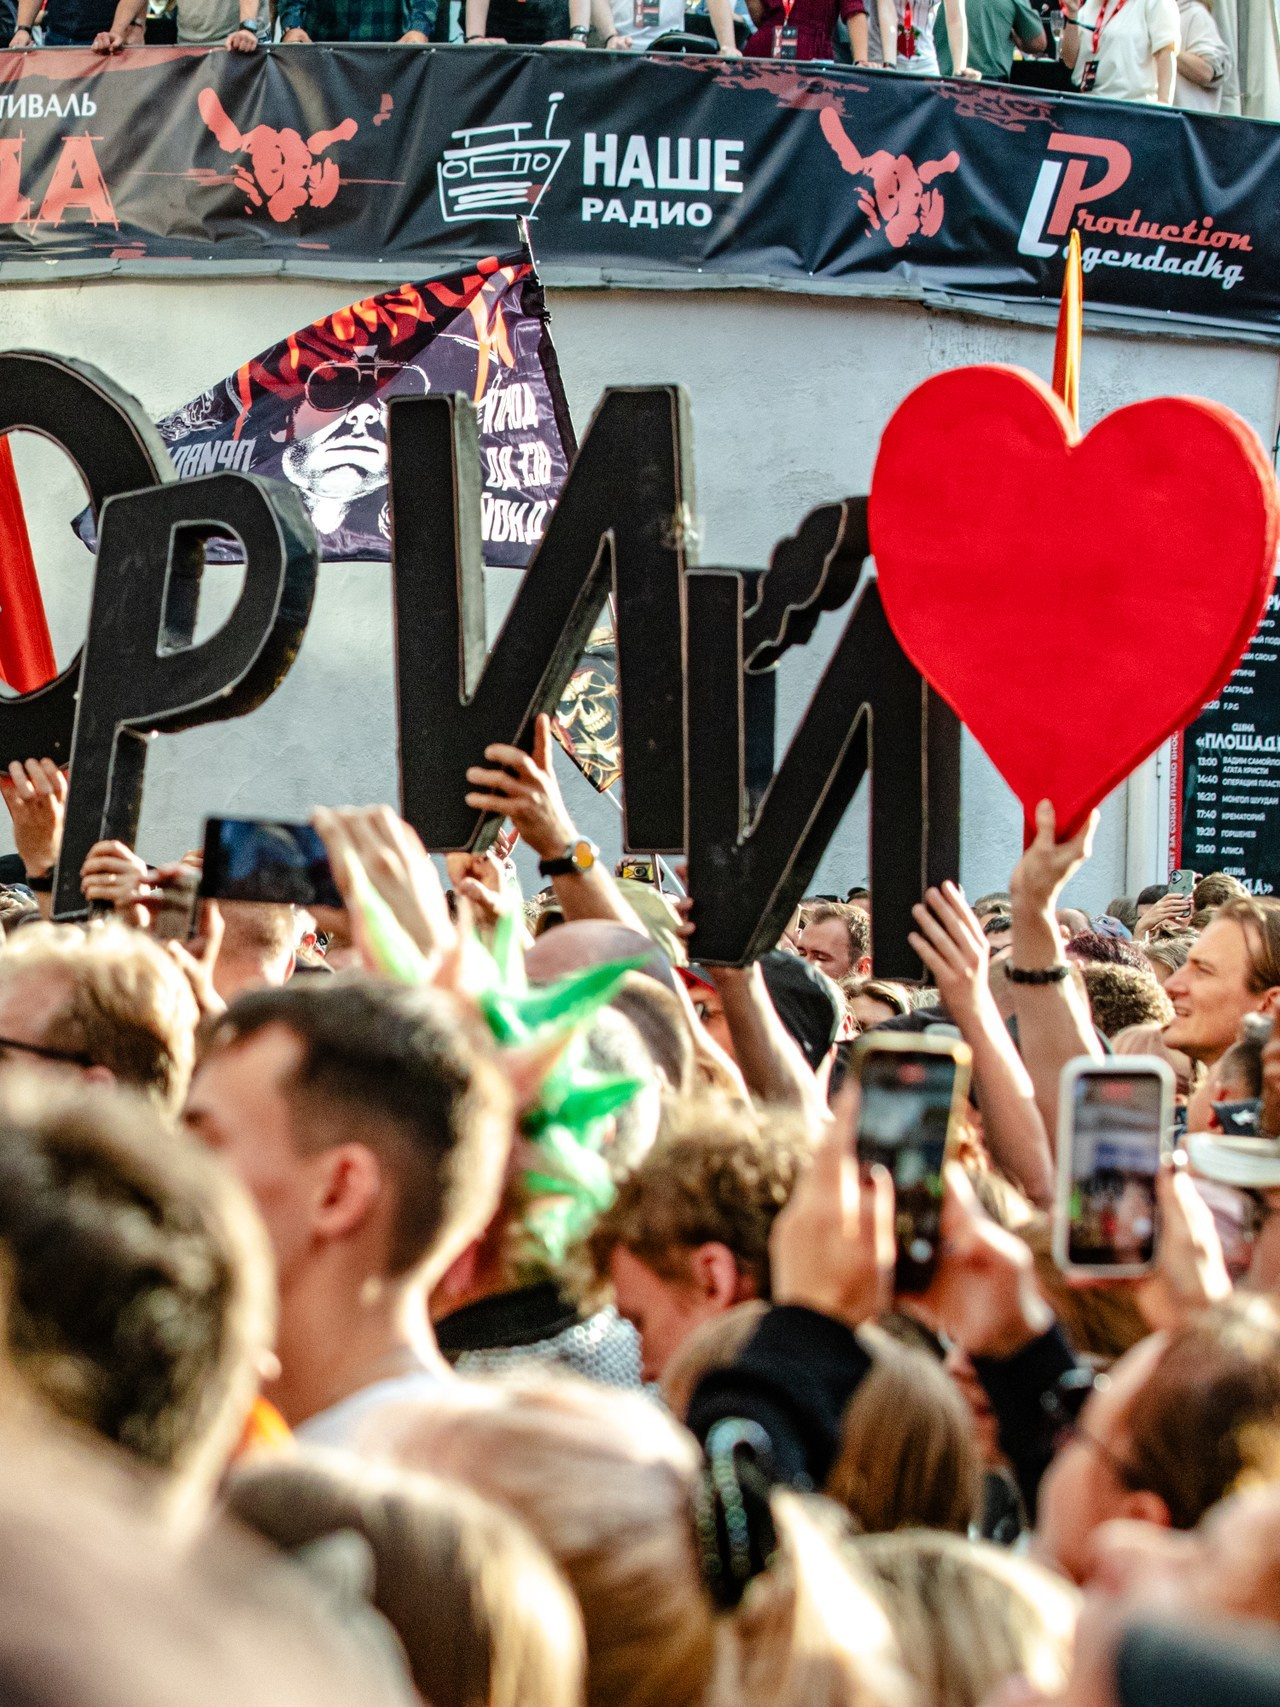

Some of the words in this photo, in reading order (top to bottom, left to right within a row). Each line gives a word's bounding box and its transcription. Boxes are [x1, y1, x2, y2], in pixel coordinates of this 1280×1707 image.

[582, 132, 744, 193] НАШЕ
[581, 197, 713, 229] РАДИО
[1231, 723, 1255, 732] СЦЕНА
[1198, 757, 1218, 766] 13:00
[1222, 756, 1247, 765] ВАДИМ
[1248, 757, 1280, 766] САМОЙЛО
[1197, 775, 1218, 784] 14:40
[1250, 797, 1279, 805] ШУУДАН
[1196, 810, 1217, 819] 17:40
[1222, 812, 1266, 821] КРЕМАТОРИЙ
[1196, 827, 1216, 836] 19:20
[1195, 844, 1216, 854] 21:00
[1221, 847, 1245, 855] АЛИСА
